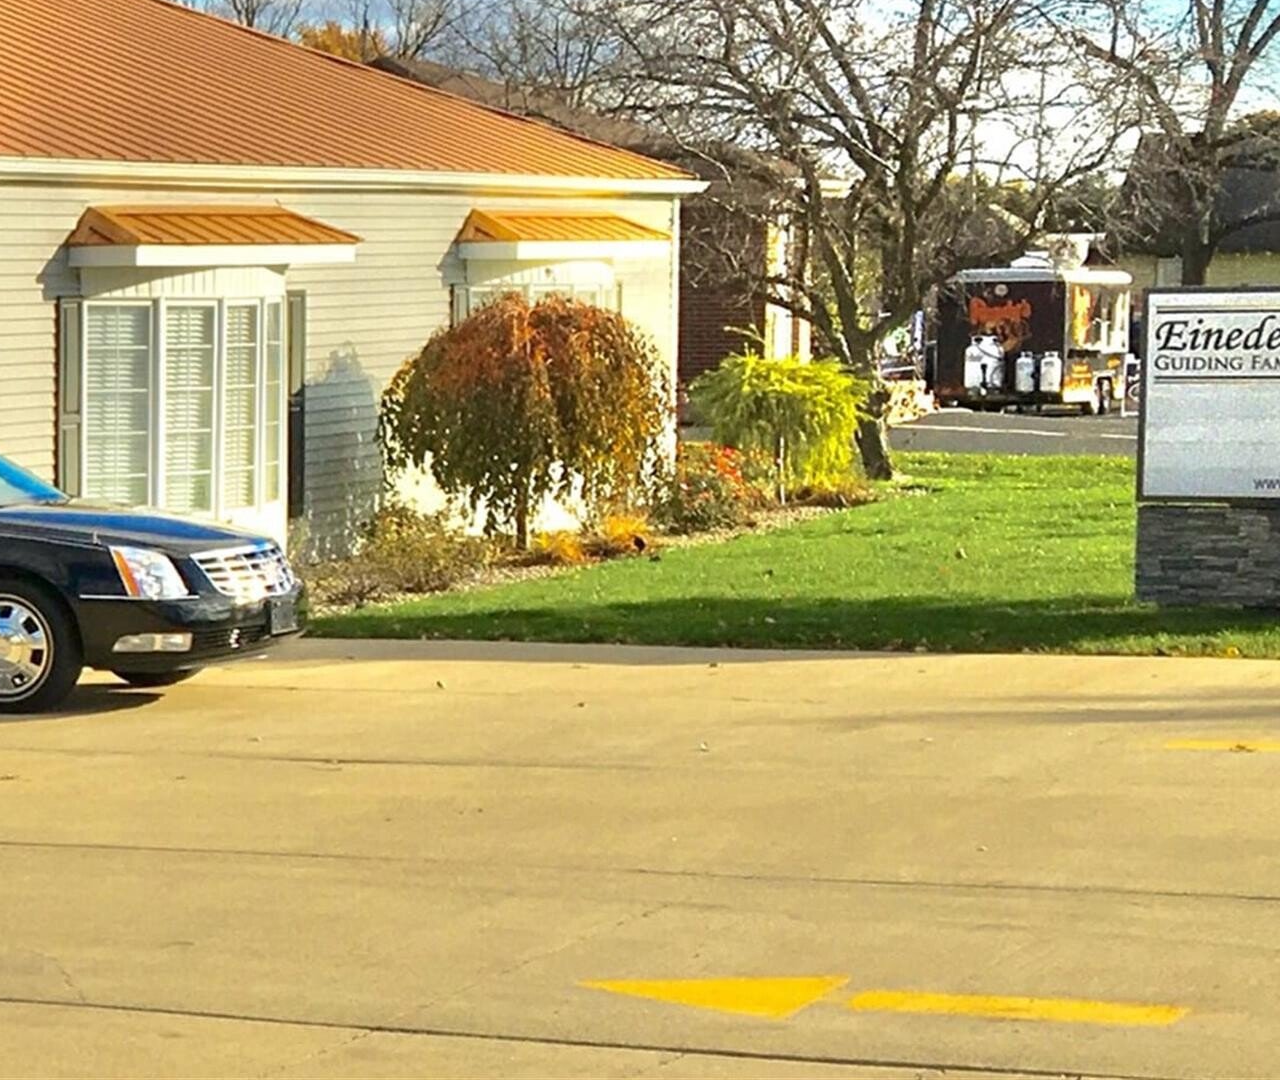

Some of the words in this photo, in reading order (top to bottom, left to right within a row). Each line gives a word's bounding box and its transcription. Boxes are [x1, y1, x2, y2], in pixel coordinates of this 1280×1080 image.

[1155, 315, 1280, 351] Einede
[1154, 355, 1244, 371] GUIDING
[1252, 478, 1280, 490] ww
